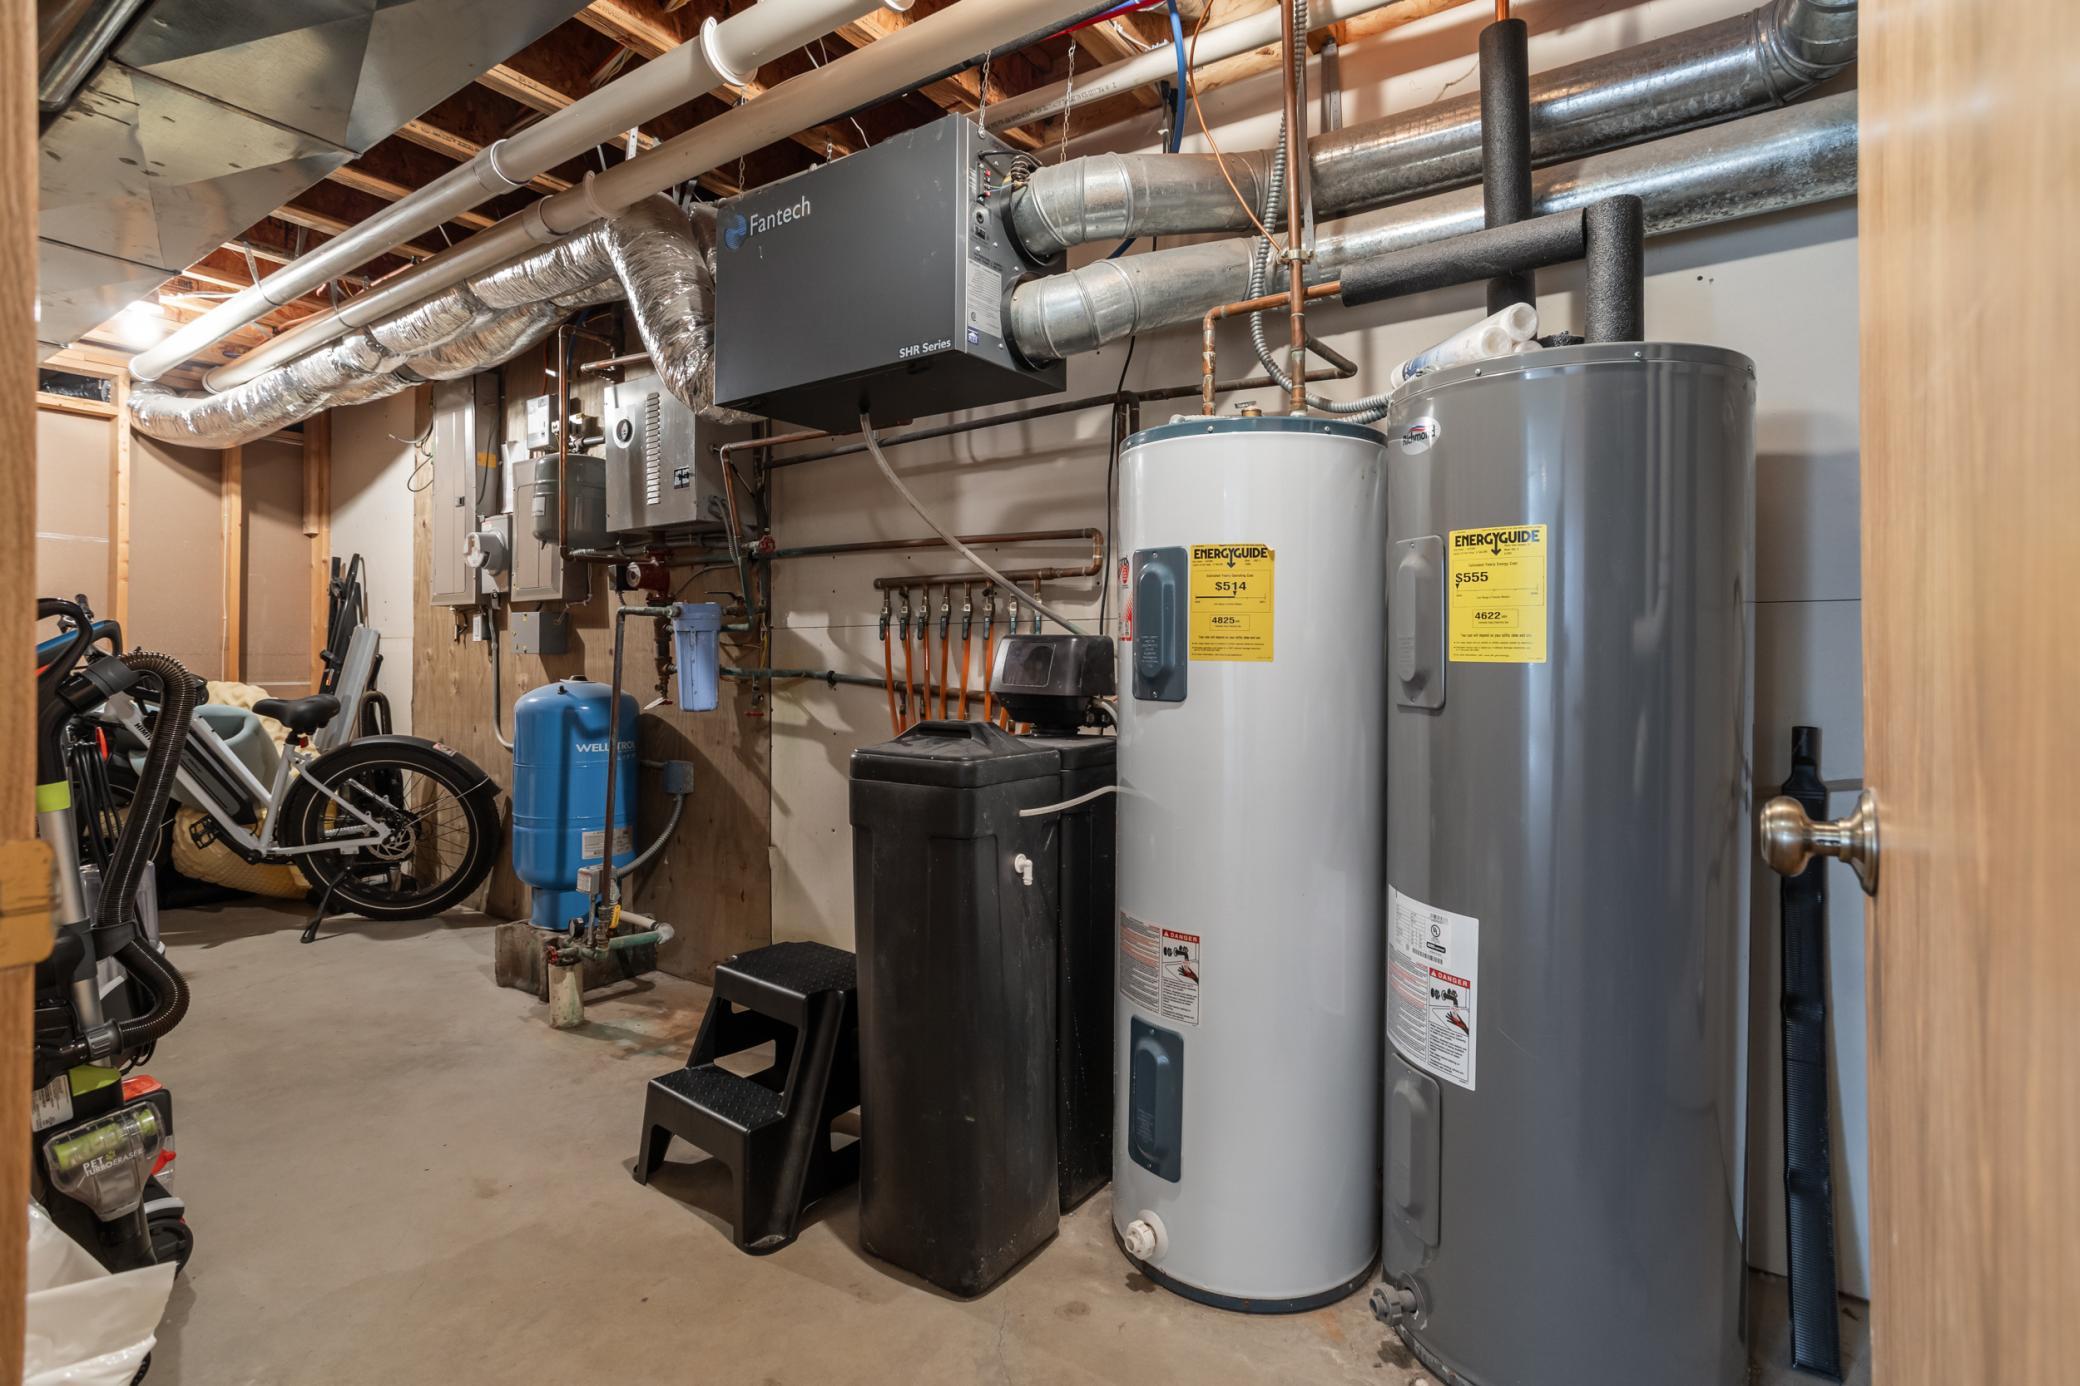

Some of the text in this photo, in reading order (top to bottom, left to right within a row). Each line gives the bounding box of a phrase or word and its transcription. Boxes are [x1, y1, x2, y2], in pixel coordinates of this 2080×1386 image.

[749, 196, 811, 237] Fantech
[899, 338, 952, 359] SHR Series
[1455, 530, 1540, 550] ENERGYGUIDE
[1193, 547, 1268, 562] ENERGYGUIDE
[1455, 571, 1489, 583] $555
[1215, 581, 1247, 591] $514
[1211, 616, 1235, 625] 4825
[1474, 611, 1501, 620] 4622
[1169, 932, 1198, 943] DANGER
[1437, 972, 1468, 987] DANGER
[82, 1156, 104, 1171] PET
